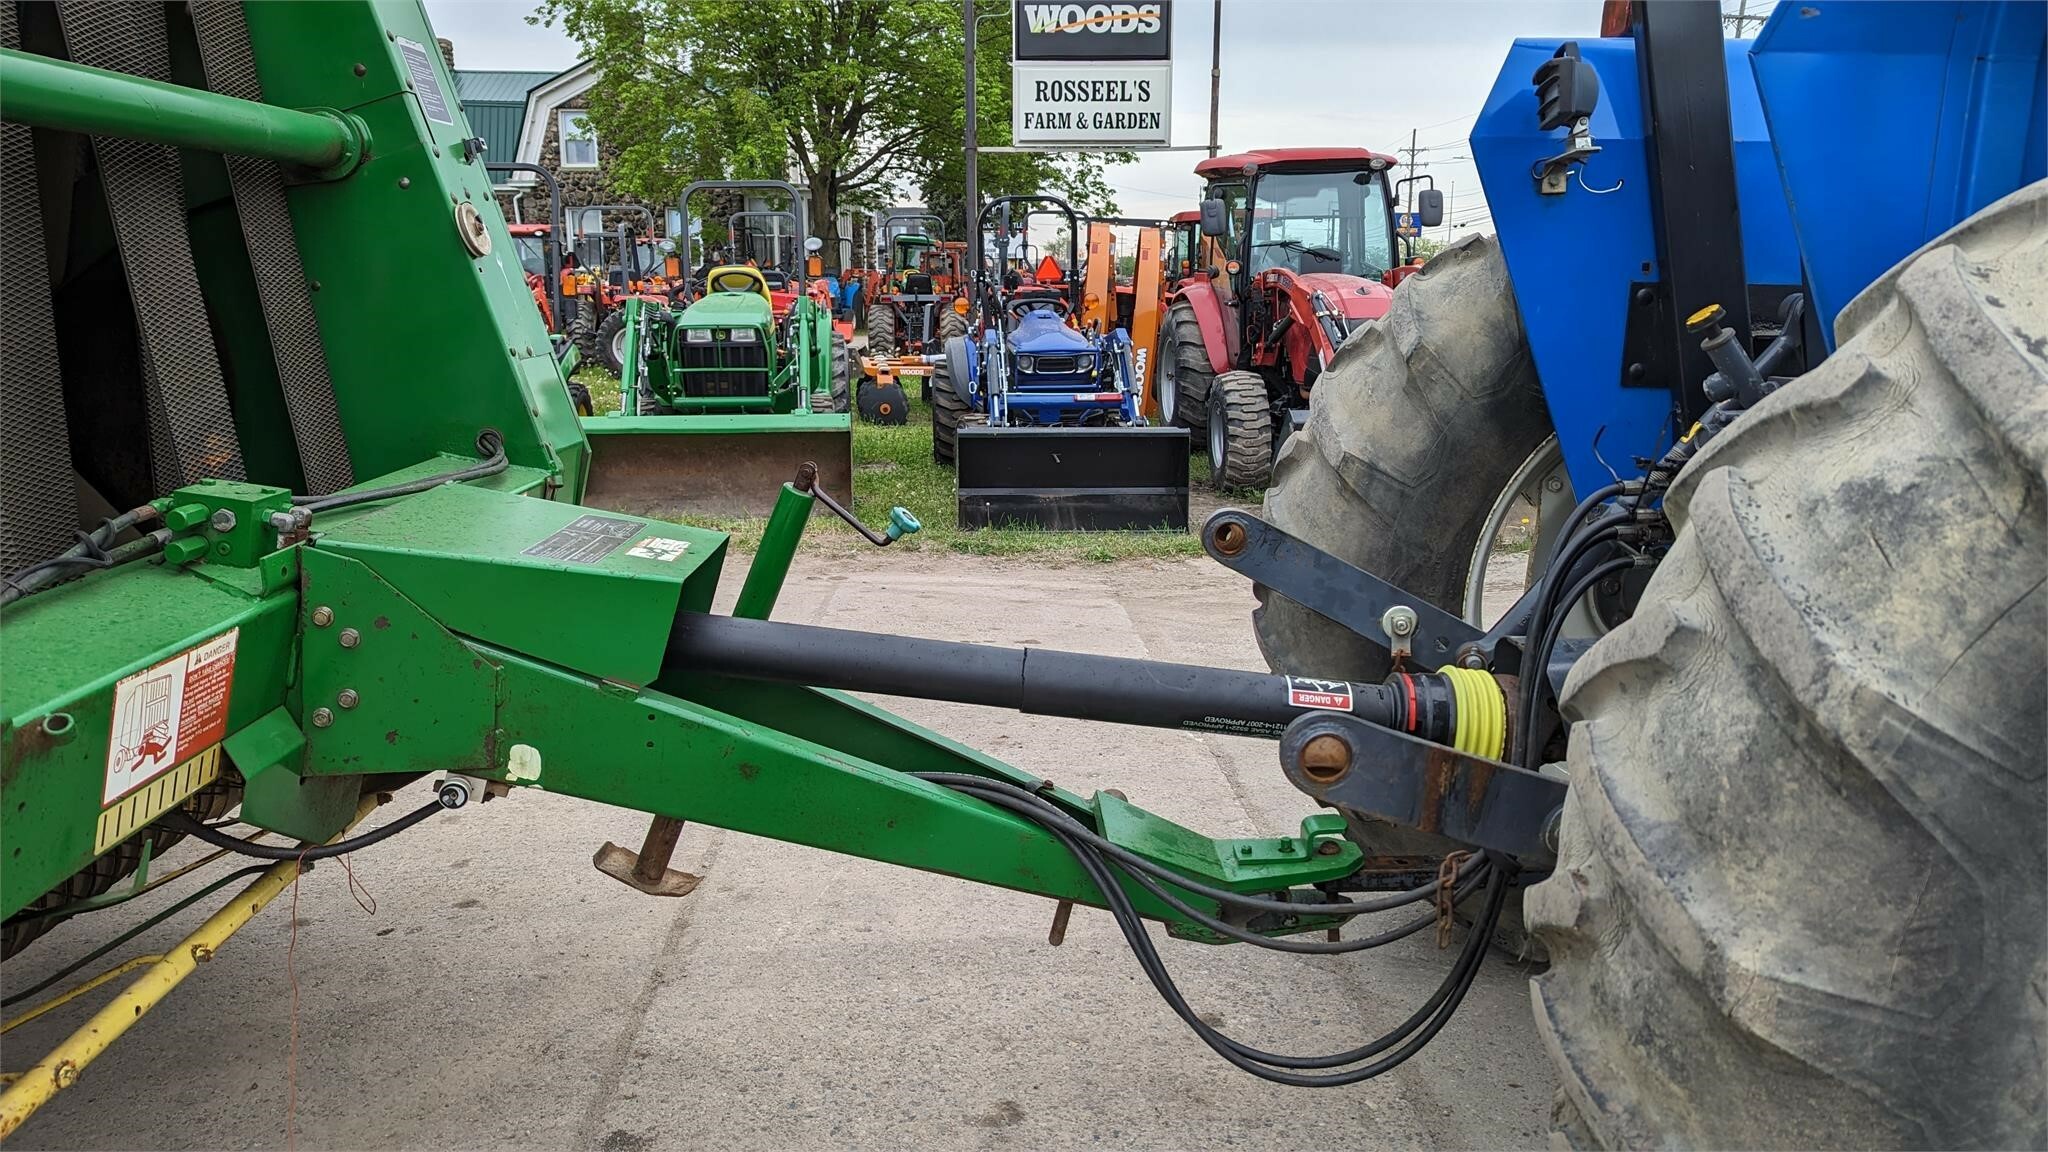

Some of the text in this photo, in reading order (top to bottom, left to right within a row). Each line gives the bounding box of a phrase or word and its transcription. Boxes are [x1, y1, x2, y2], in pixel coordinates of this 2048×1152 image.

[1024, 4, 1161, 33] WOODS
[1035, 80, 1150, 102] ROSSEEL'S
[1024, 112, 1161, 129] FARM & GARDEN
[203, 642, 231, 661] DANGER
[1298, 693, 1331, 705] DANGER
[1182, 720, 1224, 729] APPROVED
[1204, 716, 1246, 726] APPROVED
